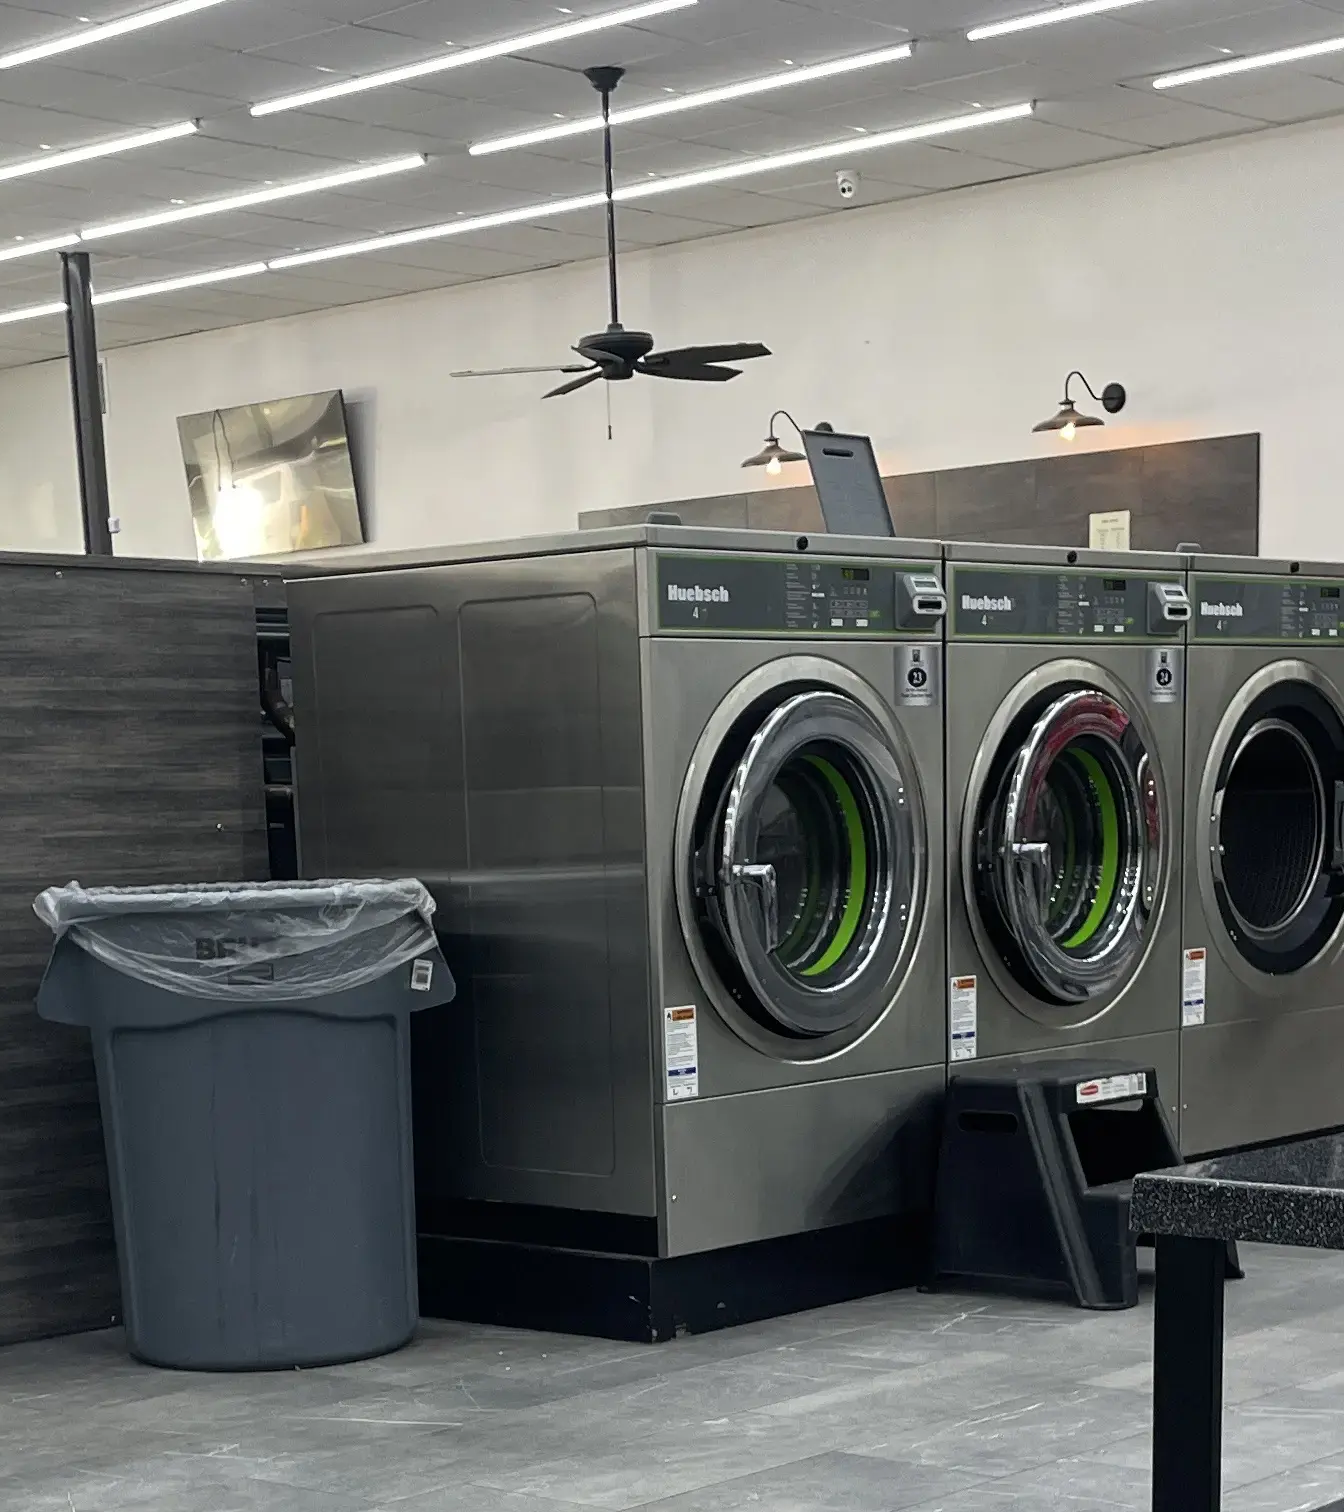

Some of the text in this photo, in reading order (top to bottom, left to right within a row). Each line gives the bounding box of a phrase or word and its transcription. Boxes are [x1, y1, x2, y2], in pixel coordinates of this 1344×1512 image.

[667, 584, 730, 603] Huebsch
[962, 594, 1012, 612] Huebsch
[1200, 601, 1244, 617] Huebsch
